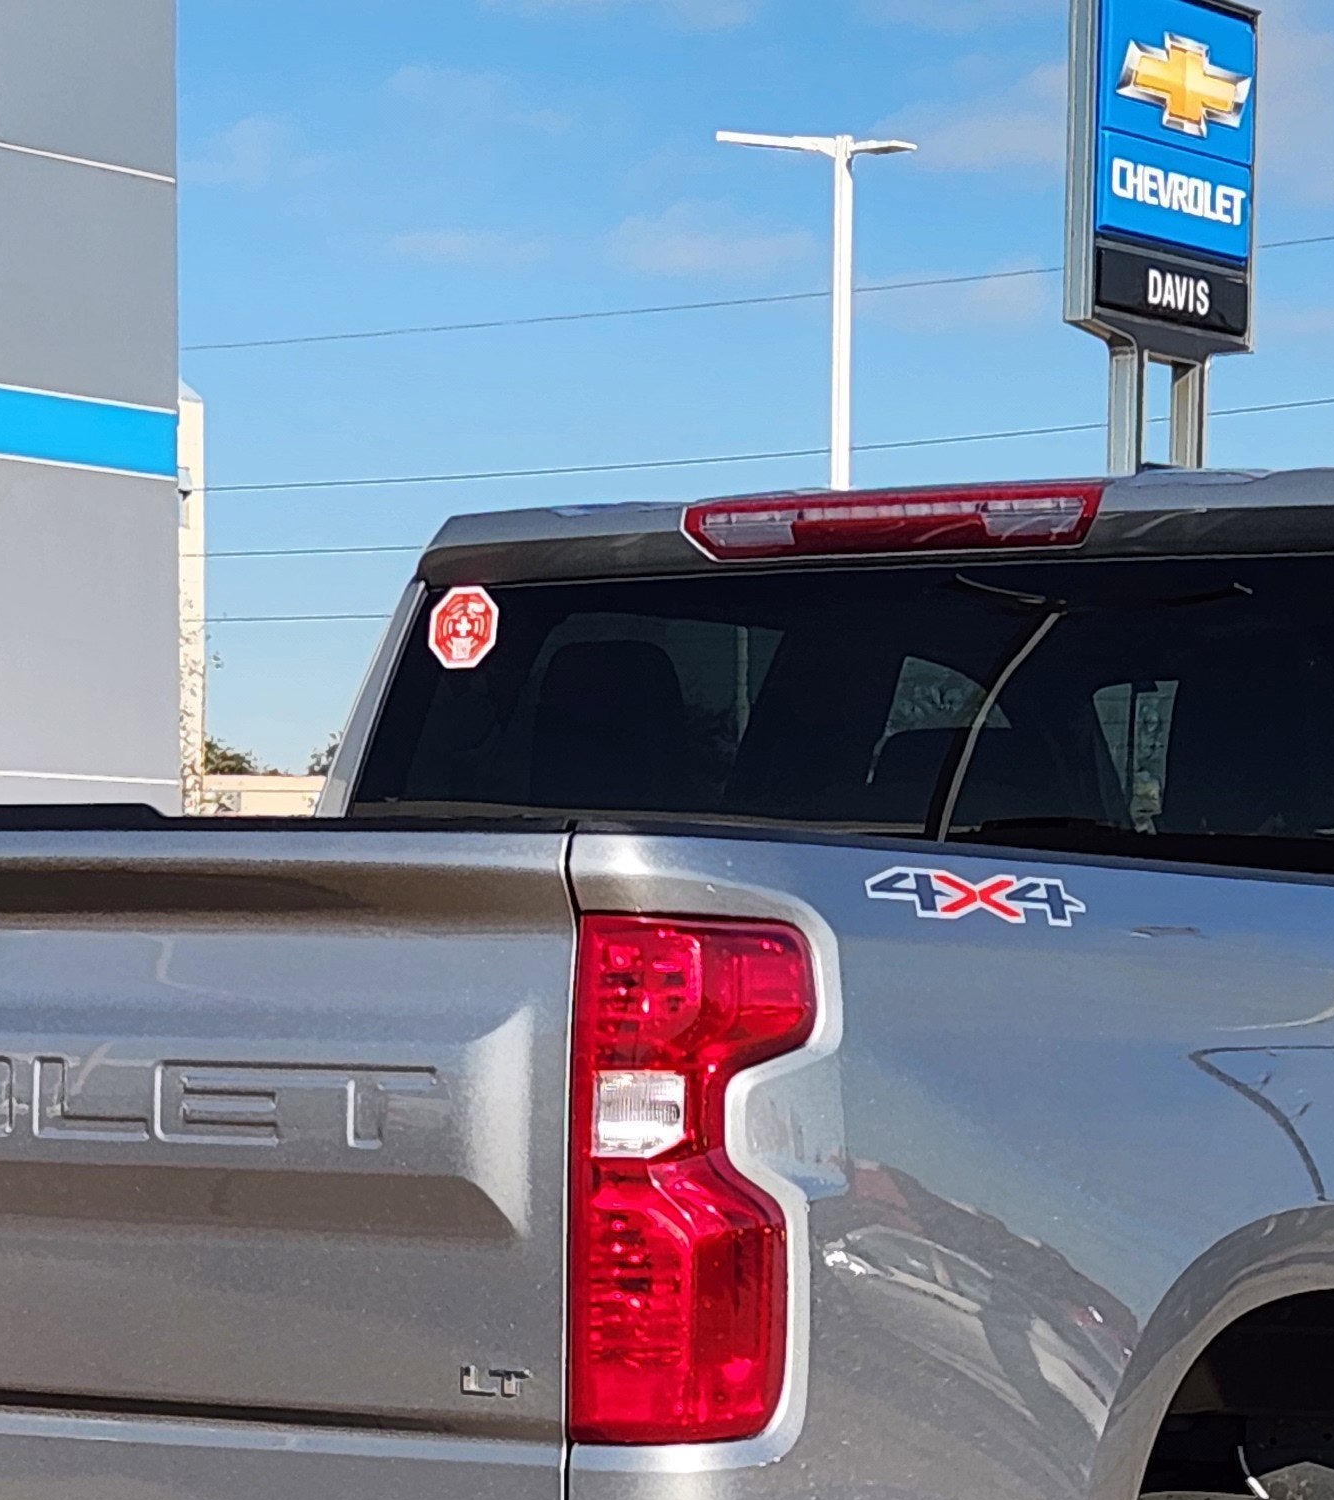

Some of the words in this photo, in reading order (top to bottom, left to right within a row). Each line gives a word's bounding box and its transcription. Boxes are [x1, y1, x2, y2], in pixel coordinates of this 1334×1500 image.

[1112, 157, 1246, 226] CHEVROLET
[1147, 267, 1210, 316] DAVIS
[460, 1364, 532, 1398] LT
